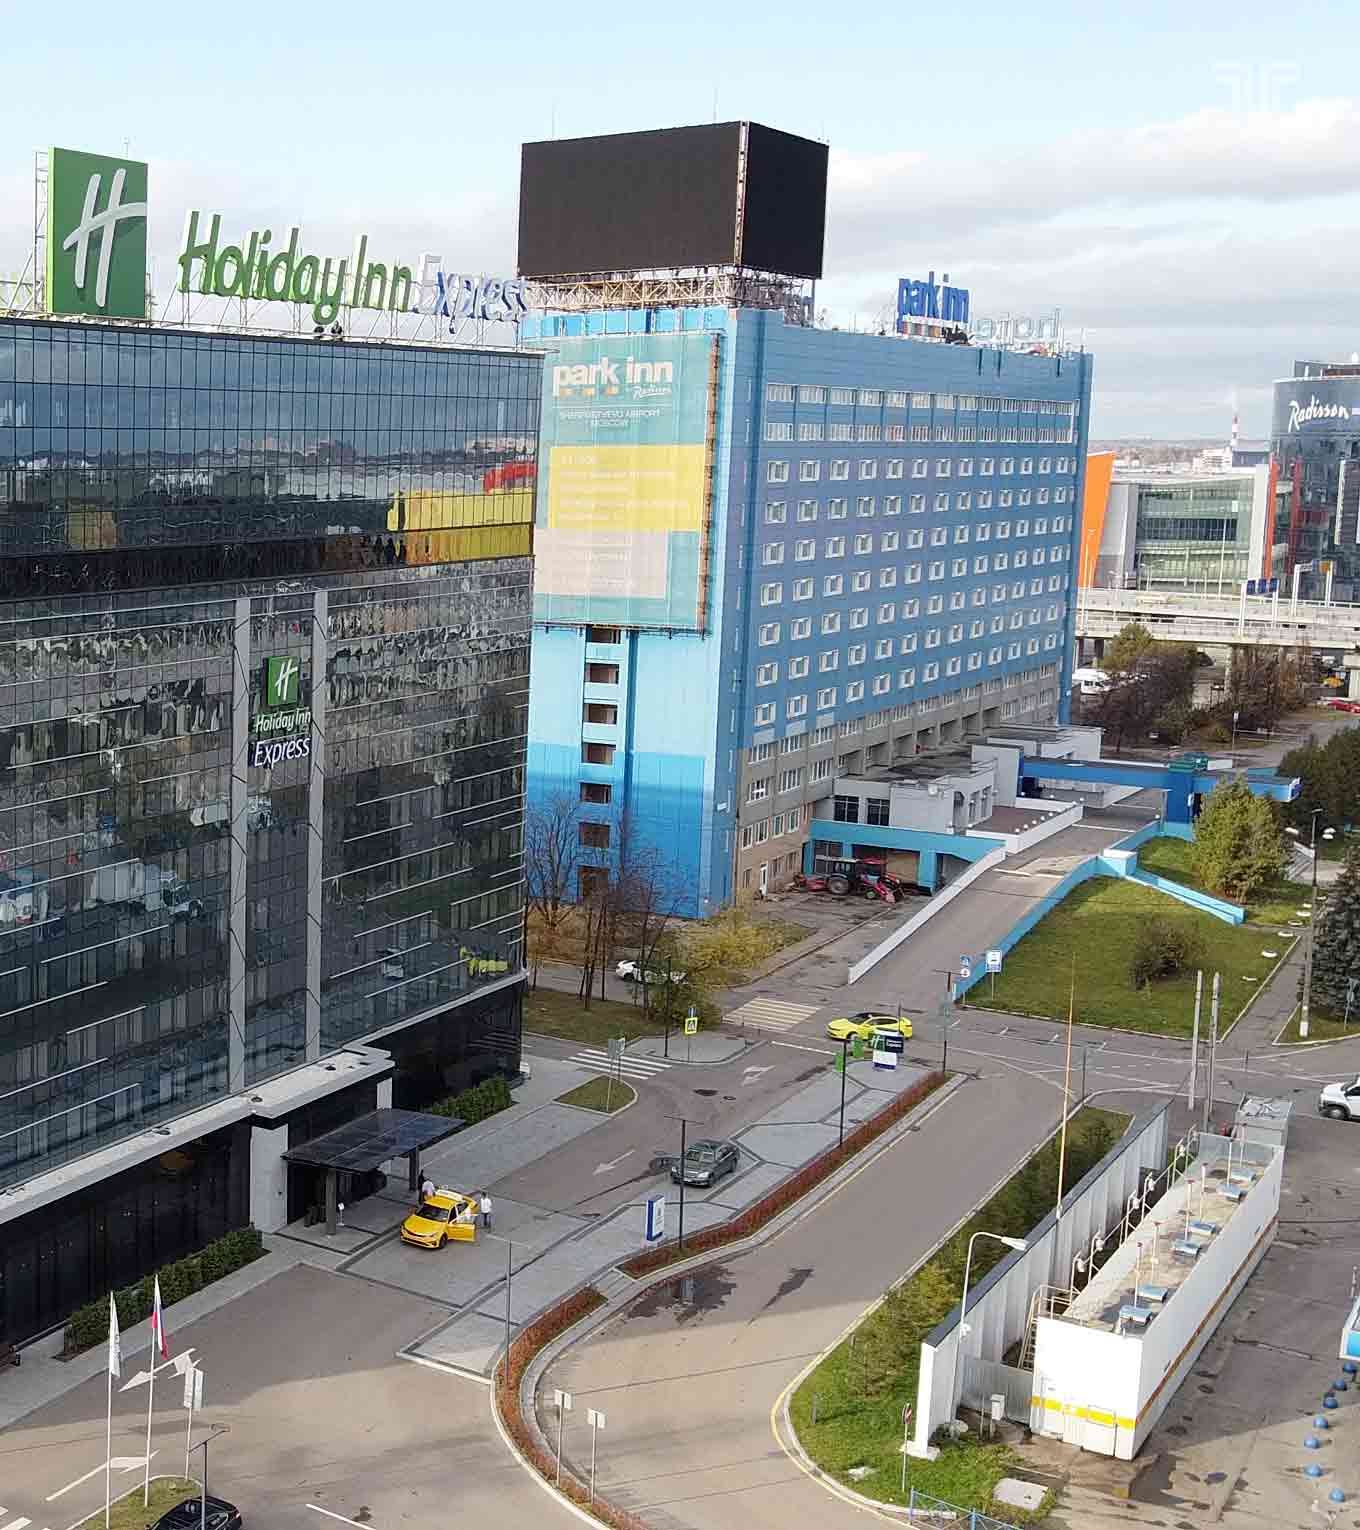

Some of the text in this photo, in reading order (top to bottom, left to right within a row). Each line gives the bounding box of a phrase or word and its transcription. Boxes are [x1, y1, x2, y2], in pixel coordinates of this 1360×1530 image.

[177, 209, 528, 334] Holiday Inn Express
[897, 271, 969, 333] park inn
[553, 355, 673, 398] park inn
[1287, 394, 1350, 433] Radisson
[254, 707, 311, 733] Holiday Inn
[254, 737, 310, 768] Express
